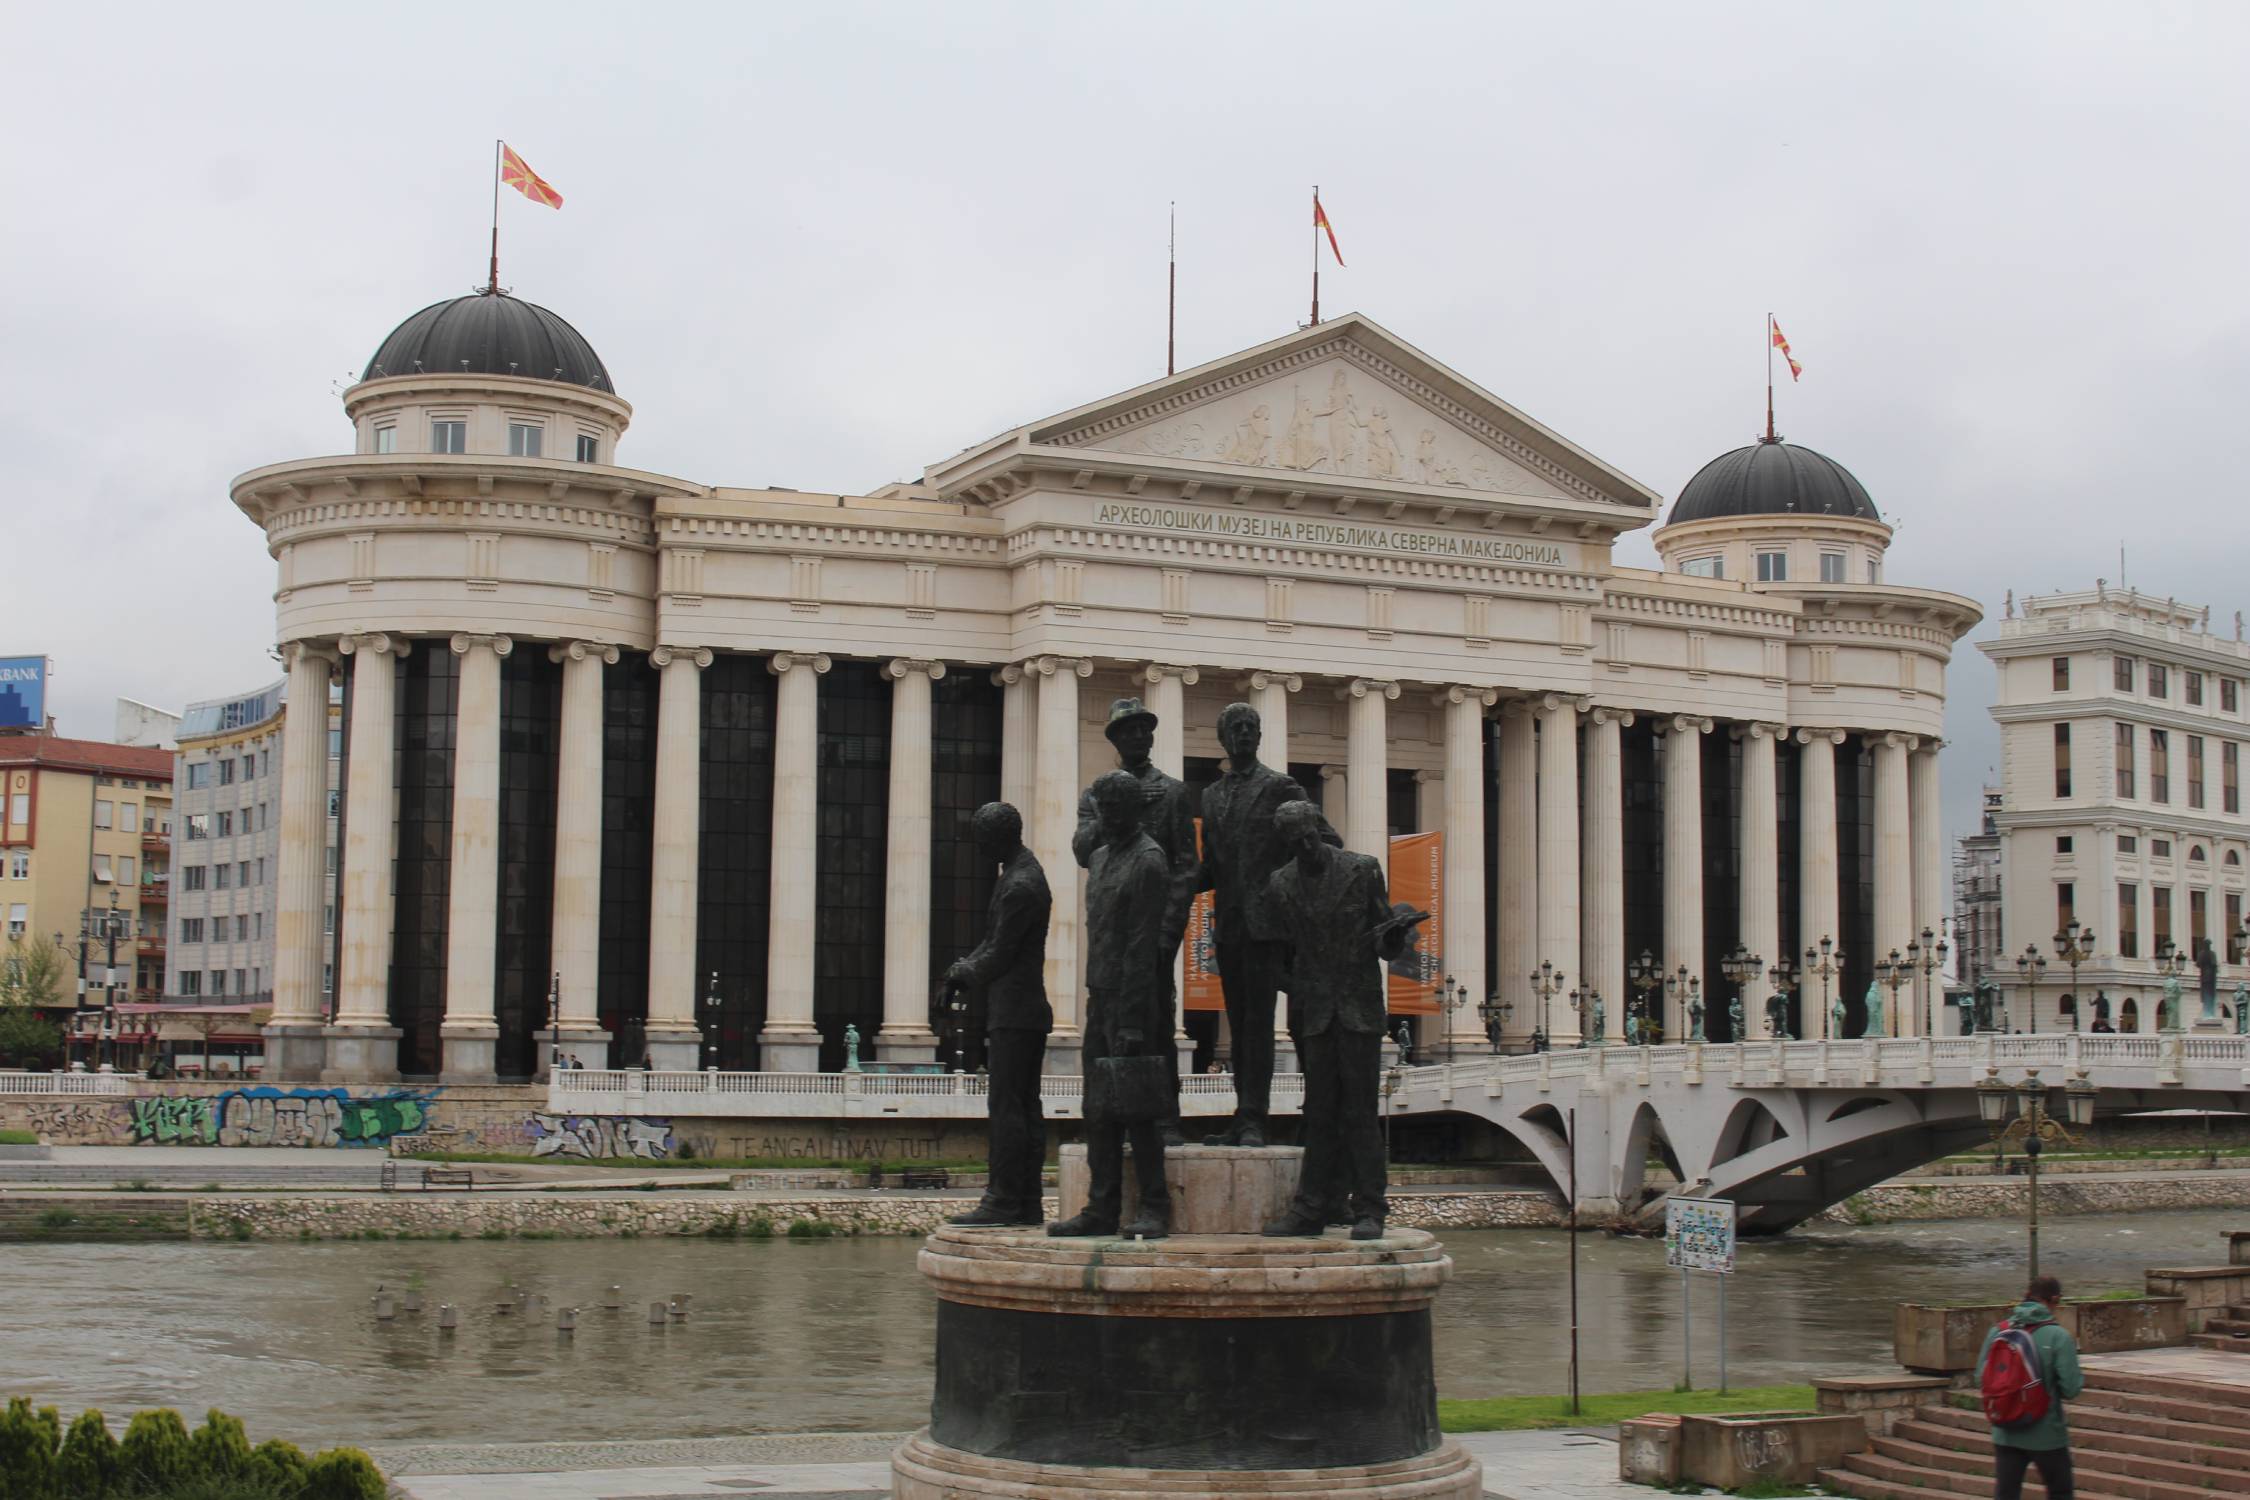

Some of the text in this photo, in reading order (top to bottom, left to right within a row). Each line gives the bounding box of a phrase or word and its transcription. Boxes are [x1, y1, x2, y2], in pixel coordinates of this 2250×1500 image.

[1099, 504, 1562, 564] АРХЕОЛОШКИ МУЗЕЈ НА РЕПУБЛИКА СЕВЕРНА МАКЕДОНИЈА
[1189, 901, 1199, 981] НАЦИОНАЛЕН
[1200, 902, 1209, 981] АРХЕОЛОШКИ
[1430, 845, 1439, 988] ARCHAEOLOGICAL MUSEUM
[1420, 934, 1429, 988] NATIONAL
